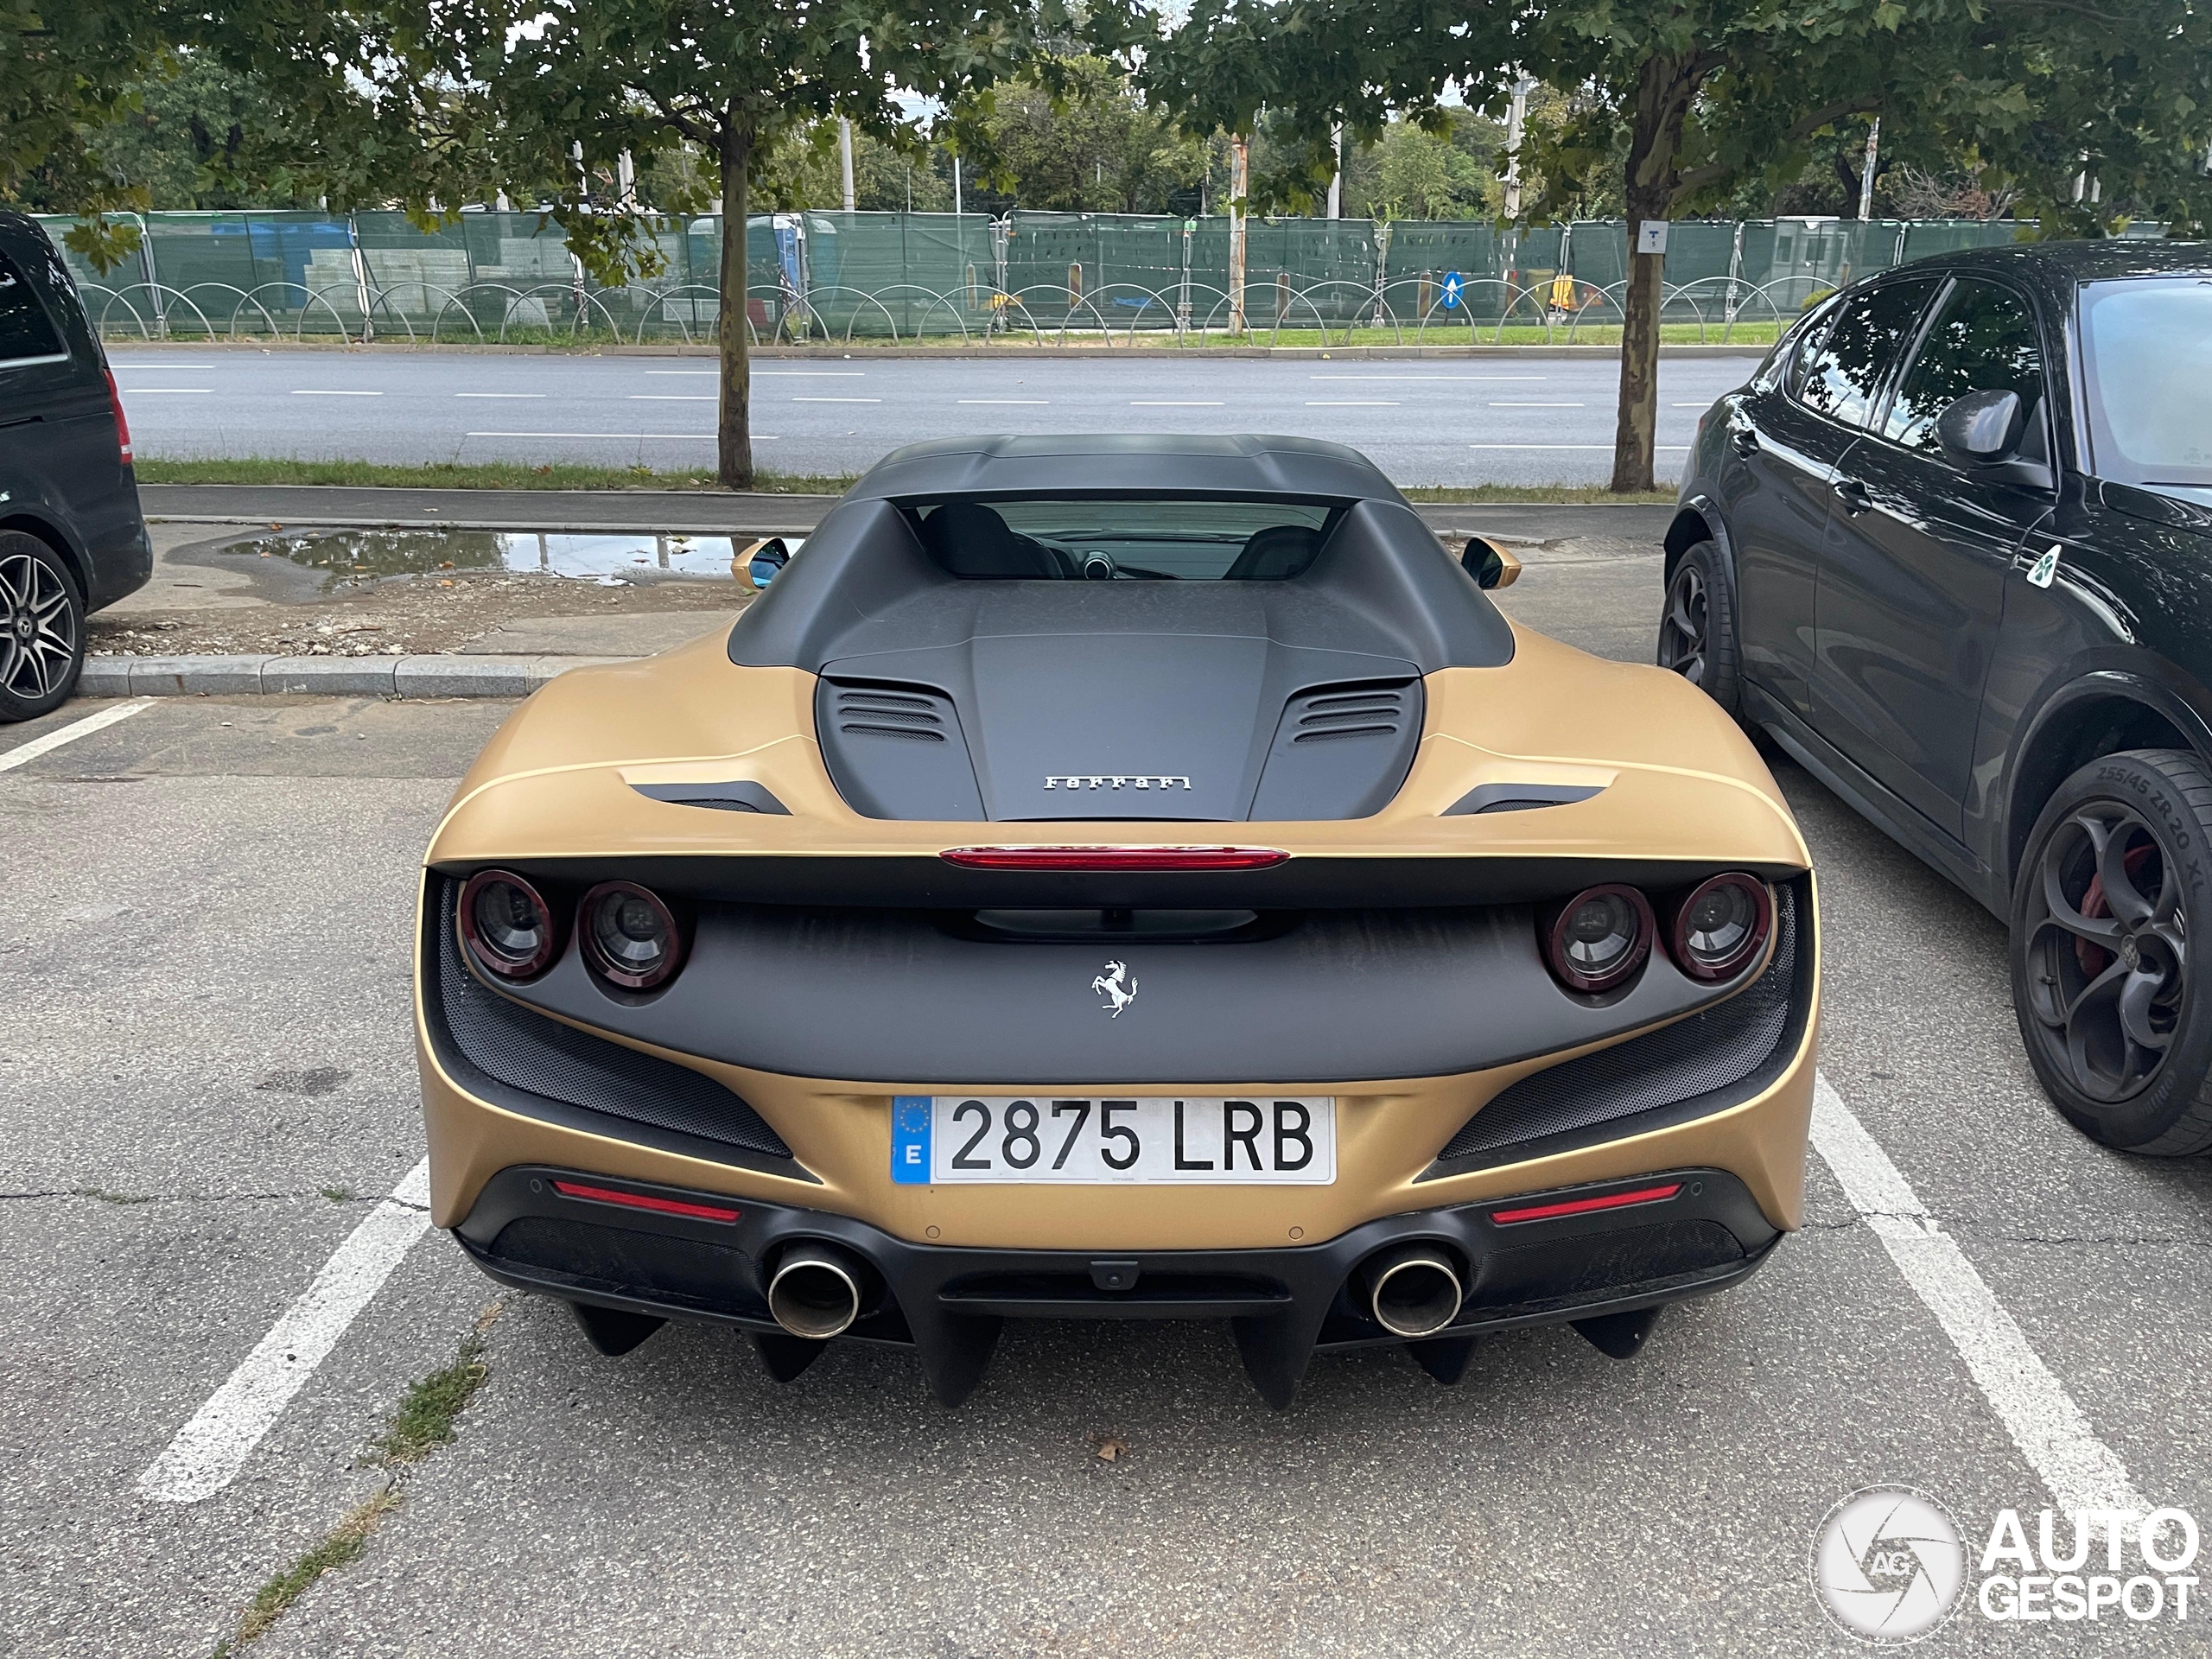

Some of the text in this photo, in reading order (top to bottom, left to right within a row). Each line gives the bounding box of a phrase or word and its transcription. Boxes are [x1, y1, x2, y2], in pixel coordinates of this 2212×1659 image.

[1043, 775, 1192, 791] Ferrari
[2097, 766, 2151, 794] 255/45
[2150, 790, 2172, 819] ZR
[2168, 817, 2190, 849] 20
[906, 1145, 921, 1164] E
[950, 1099, 1313, 1171] 2875 LRB
